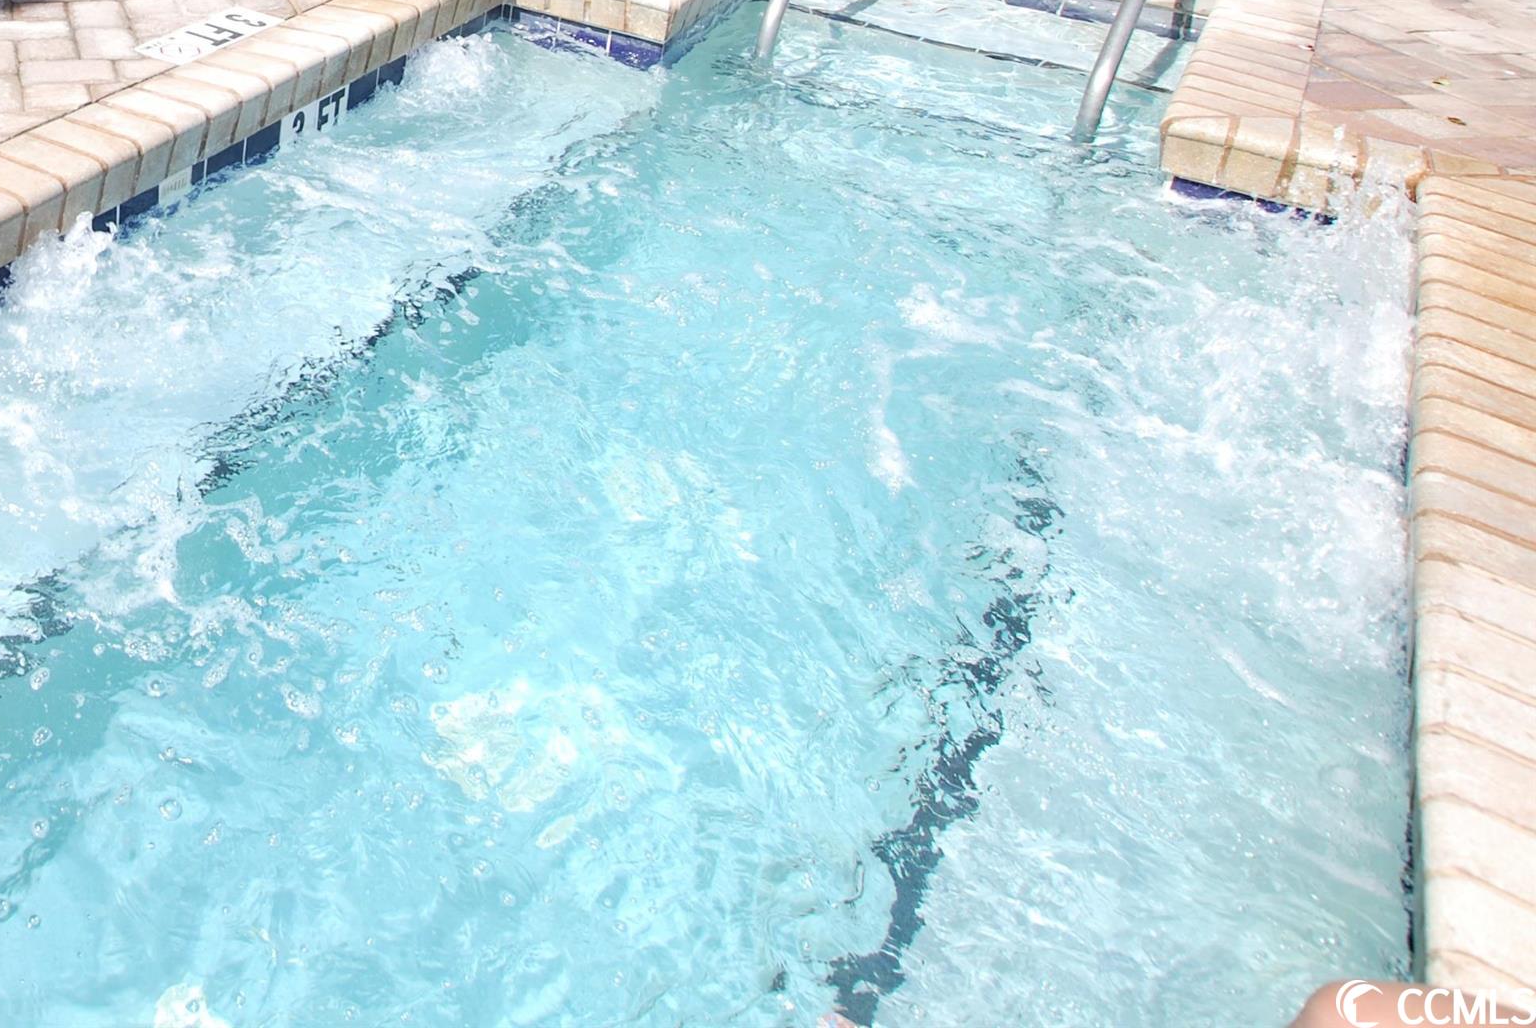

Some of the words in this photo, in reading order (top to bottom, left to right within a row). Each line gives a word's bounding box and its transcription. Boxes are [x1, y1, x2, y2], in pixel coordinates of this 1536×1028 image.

[225, 13, 267, 28] 3
[185, 23, 244, 47] FT
[316, 87, 346, 132] FT
